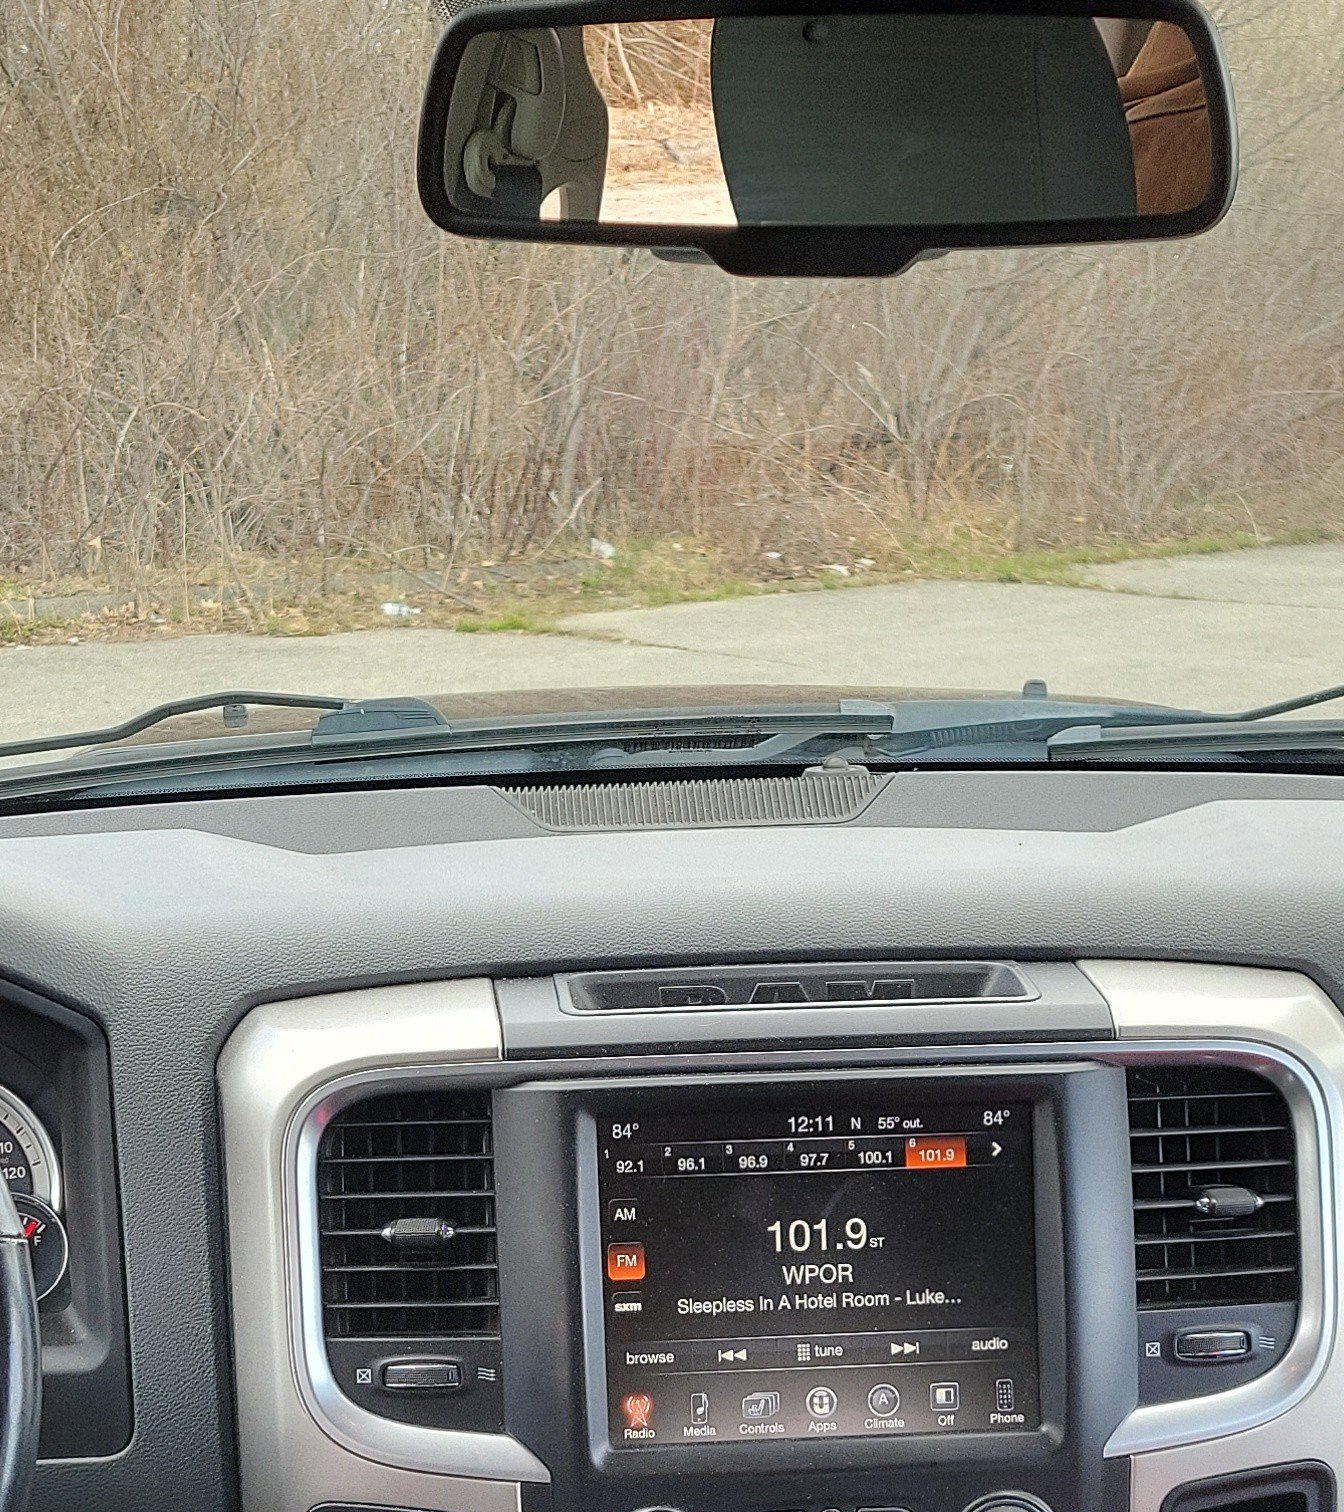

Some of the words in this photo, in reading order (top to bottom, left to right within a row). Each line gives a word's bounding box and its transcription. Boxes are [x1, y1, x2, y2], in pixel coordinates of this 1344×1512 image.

[851, 1117, 861, 1130] N
[902, 1117, 924, 1130] out.
[983, 1109, 1011, 1126] 84°
[611, 1123, 640, 1139] 84°
[787, 1116, 834, 1134] 12:11
[738, 1154, 768, 1169] 96.9
[800, 1152, 829, 1166] 97.7
[857, 1149, 893, 1164] 100.1
[918, 1148, 955, 1163] 101.9
[616, 1159, 645, 1174] 92.1
[677, 1156, 706, 1171] 96.1
[3, 1167, 26, 1179] 120
[614, 1207, 636, 1221] AM
[34, 1236, 42, 1246] F
[767, 1217, 868, 1252] 101.9
[616, 1254, 638, 1268] FM
[782, 1263, 854, 1285] WPOR
[677, 1296, 755, 1316] Sleepless
[759, 1297, 774, 1312] In
[777, 1296, 791, 1310] A
[795, 1294, 838, 1310] Hotel
[842, 1292, 890, 1308] Room
[906, 1290, 961, 1306] Luke...
[814, 1343, 844, 1357] tune
[971, 1337, 1009, 1351] audio
[626, 1350, 675, 1365] browse
[864, 1416, 904, 1429] Climate
[937, 1414, 955, 1426] Off
[990, 1412, 1025, 1425] Phone
[624, 1427, 656, 1439] Radio
[683, 1424, 717, 1436] Media
[739, 1422, 785, 1434] Controls
[808, 1420, 837, 1433] Apps
